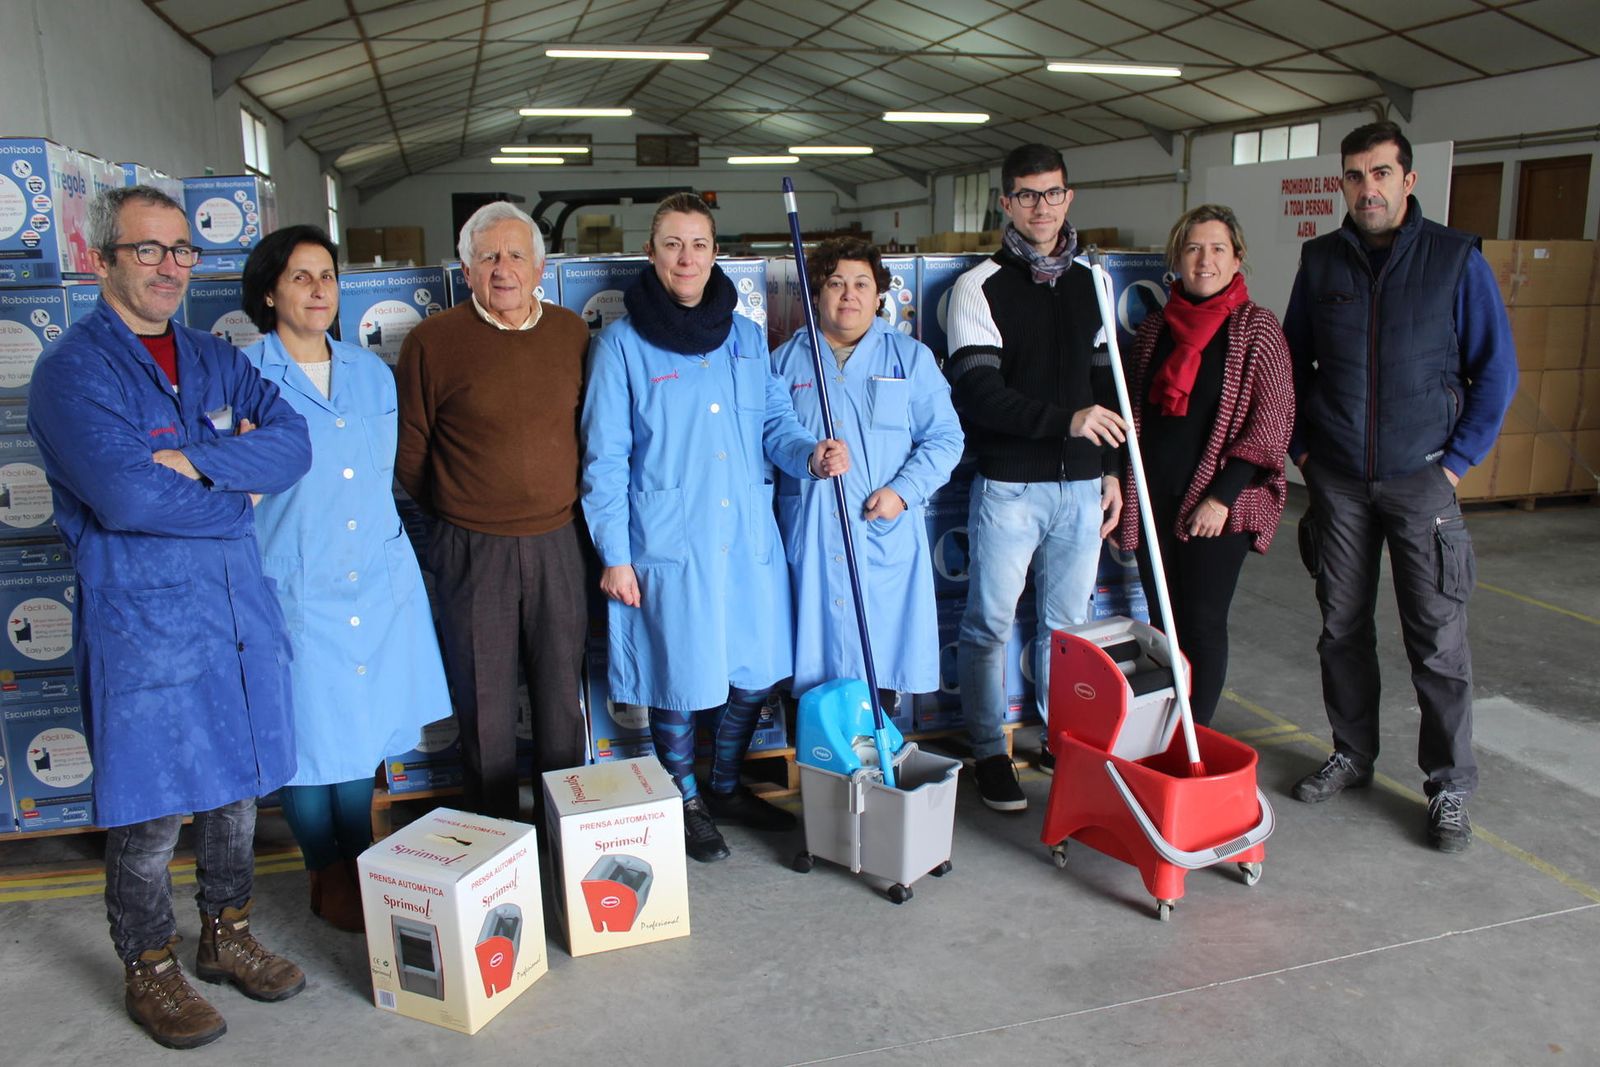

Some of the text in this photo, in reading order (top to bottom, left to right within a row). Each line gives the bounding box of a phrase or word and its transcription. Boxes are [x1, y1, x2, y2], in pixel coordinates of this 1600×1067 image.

[1281, 176, 1339, 194] PROHIBIDO EL PASO
[1284, 199, 1333, 216] A TODA PERSONA
[1297, 221, 1316, 237] AJENA
[566, 269, 608, 277] Escurridor
[340, 275, 441, 289] Escurridor Robotizado
[2, 295, 61, 304] Robotizado
[191, 288, 237, 297] Escurridor
[4, 708, 50, 719] Escurridor
[433, 818, 460, 826] PRENSA
[580, 812, 665, 831] PRENSA AUTOMÁTICA
[595, 826, 648, 852] Sprimsol
[391, 844, 467, 865] Sprimsol
[369, 872, 444, 897] PRENSA AUTOMÁTICA
[471, 871, 493, 890] PRENSA
[482, 867, 518, 907] Sprimsol
[383, 894, 431, 919] Sprimsol
